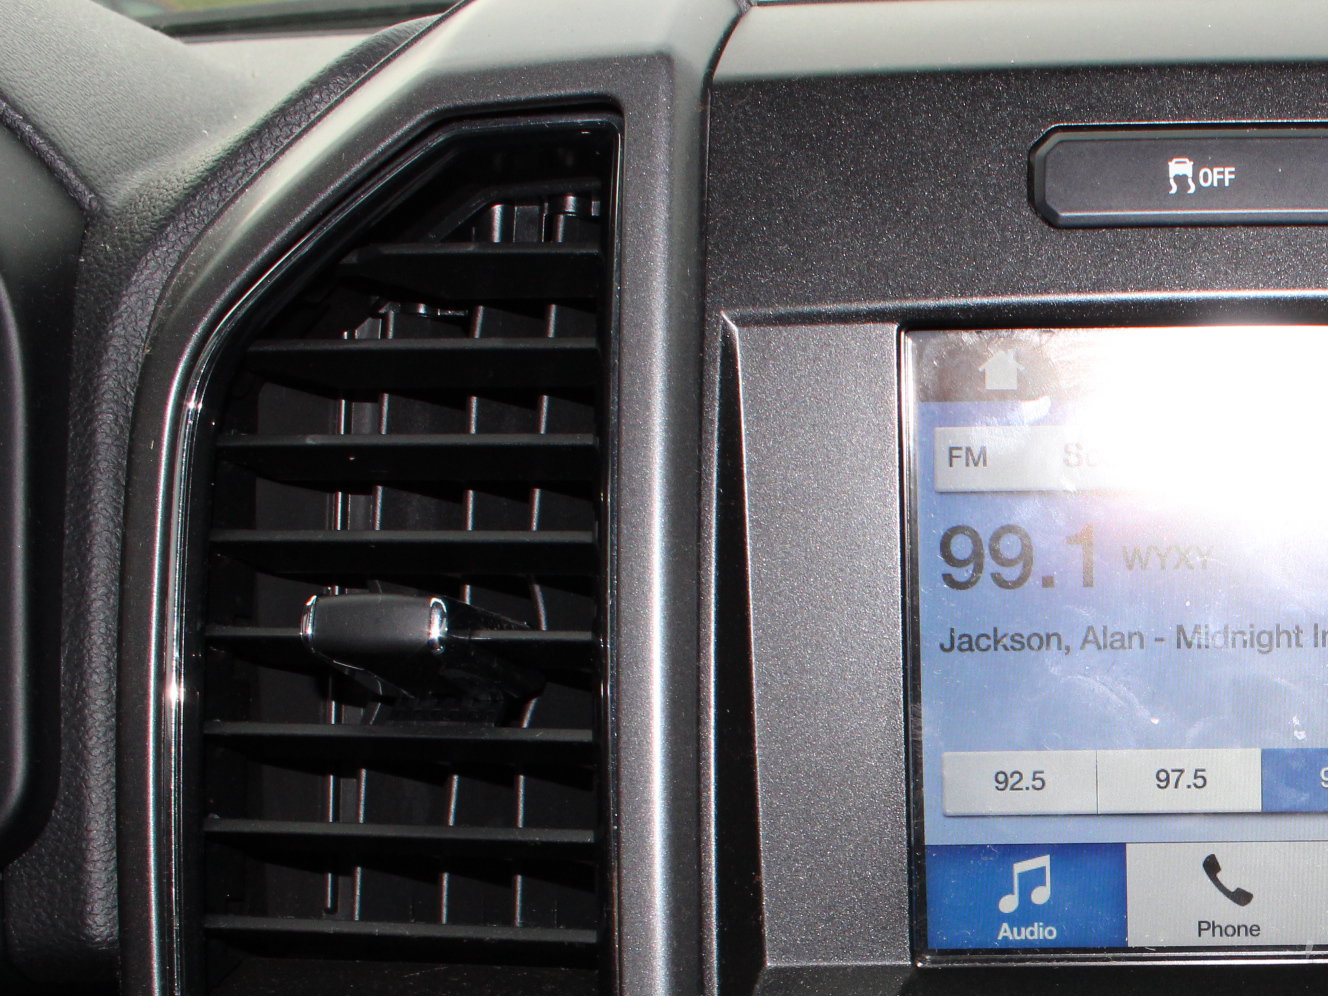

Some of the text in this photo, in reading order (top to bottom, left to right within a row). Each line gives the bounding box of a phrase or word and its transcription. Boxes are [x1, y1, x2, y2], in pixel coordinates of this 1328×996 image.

[1198, 167, 1236, 188] OFF
[947, 446, 988, 468] FM
[938, 523, 1096, 591] 99.1
[1122, 546, 1212, 571] WYXY
[939, 624, 1072, 656] Jackson,
[1080, 625, 1146, 651] Alan
[1176, 624, 1304, 655] Midnight
[993, 770, 1046, 792] 92.5
[1155, 768, 1208, 790] 97.5
[997, 922, 1057, 941] Audio
[1197, 920, 1261, 939] Phone
